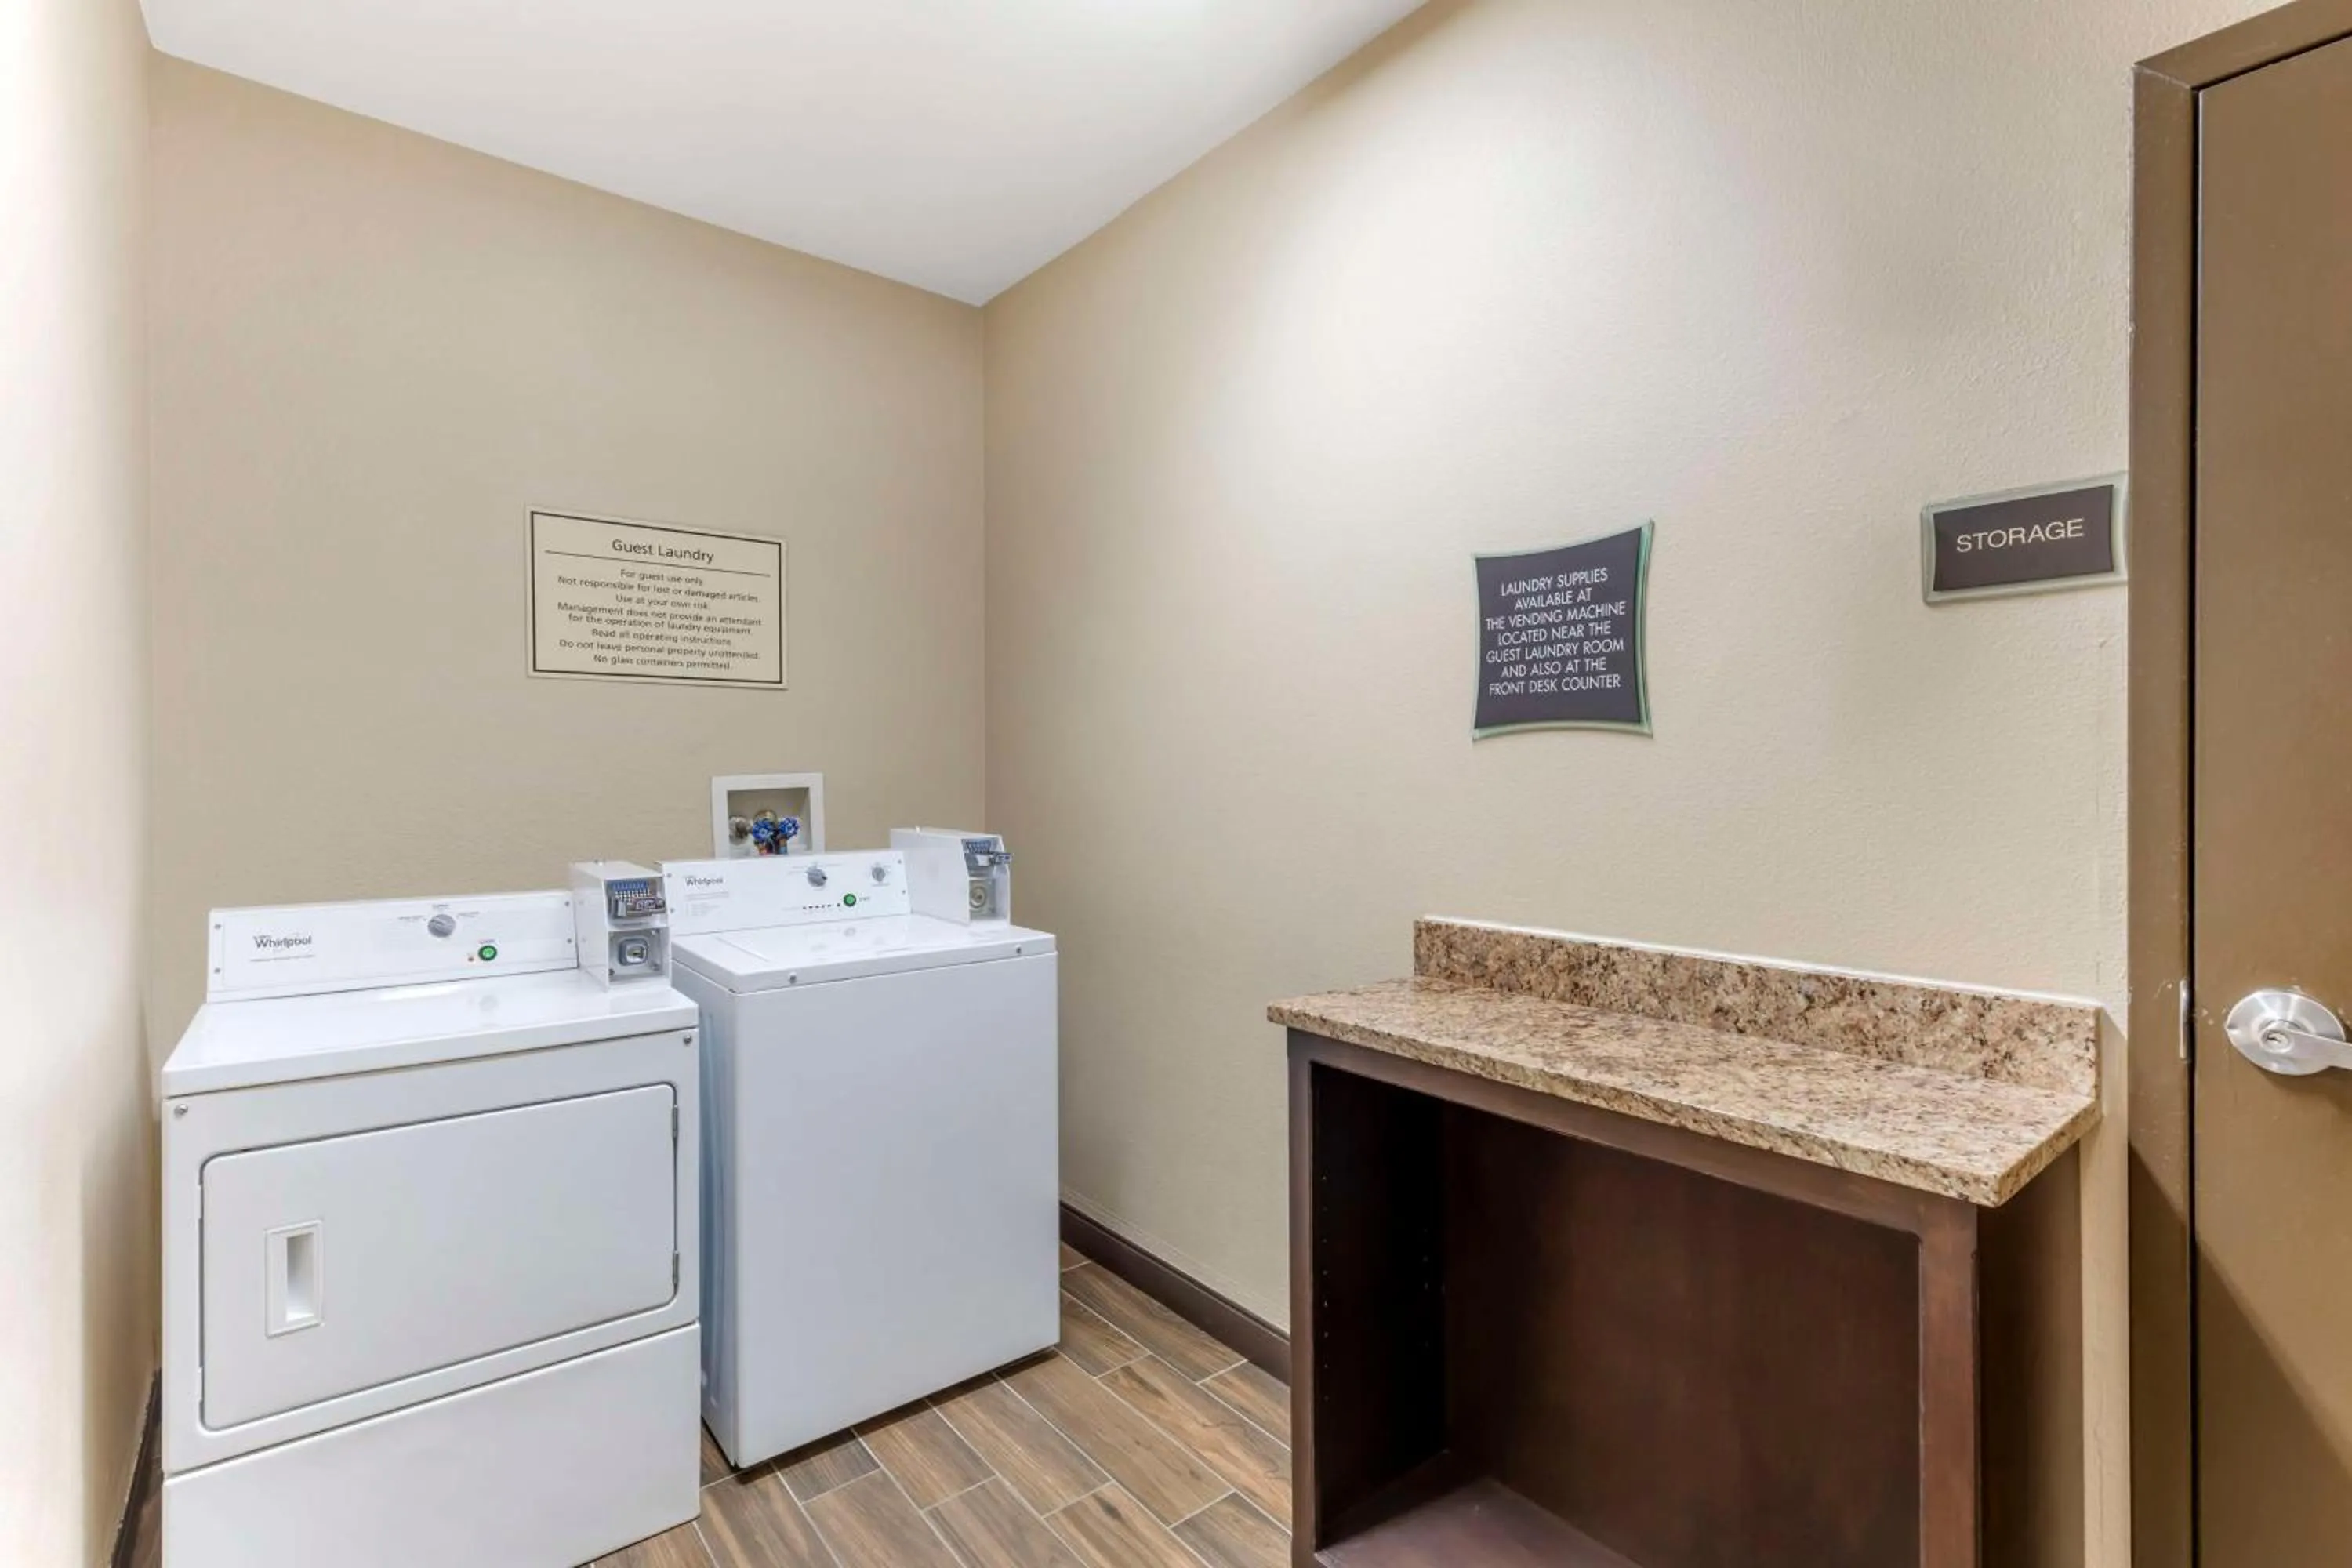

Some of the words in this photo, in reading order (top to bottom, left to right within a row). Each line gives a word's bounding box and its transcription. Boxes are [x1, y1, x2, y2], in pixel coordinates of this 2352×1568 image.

[1956, 517, 2083, 553] STORAGE
[612, 539, 653, 555] Guest
[657, 543, 714, 564] Laundry
[620, 568, 636, 578] For
[639, 573, 664, 583] guest
[1501, 576, 1553, 596] LAUNDRY
[1557, 568, 1608, 588] SUPPLIES
[557, 575, 577, 585] Not
[579, 579, 634, 591] responsible
[637, 583, 651, 593] for
[653, 585, 670, 594] lost
[684, 589, 727, 601] damaged
[1514, 590, 1573, 610] AVAILABLE
[1577, 587, 1593, 602] AT
[615, 593, 633, 603] Use
[635, 596, 645, 604] at
[647, 598, 667, 607] your
[557, 601, 625, 615] Management
[626, 608, 648, 618] does
[669, 612, 703, 622] provide
[719, 616, 761, 626] attendant
[568, 612, 583, 622] for
[586, 615, 603, 624] the
[604, 618, 652, 630] operation
[654, 619, 666, 629] of
[667, 621, 701, 633] laundry
[1486, 615, 1505, 631] THE
[1508, 609, 1563, 630] VENDING
[1567, 601, 1627, 621] MACHINE
[591, 627, 615, 638] Read
[619, 630, 630, 639] all
[633, 633, 678, 644] operating
[1497, 628, 1548, 647] LOCATED
[1552, 625, 1584, 640] NEAR
[1588, 620, 1612, 635] THE
[559, 639, 575, 648] Do
[577, 641, 594, 650] not
[597, 642, 622, 652] leave
[625, 644, 665, 654] personal
[666, 647, 706, 658] property
[1486, 648, 1522, 664] GUEST
[1525, 642, 1579, 659] LAUNDRY
[1582, 637, 1625, 655] ROOM
[593, 654, 608, 662] No
[611, 655, 633, 666] glass
[636, 657, 684, 668] containers
[1501, 664, 1527, 679] AND
[1530, 661, 1562, 676] ALSO
[1565, 659, 1581, 673] AT
[1584, 656, 1607, 671] THE
[1489, 681, 1525, 697] FRONT
[1529, 678, 1559, 694] DESK
[1561, 673, 1621, 691] COUNTER
[253, 935, 313, 949] Whirlpool
